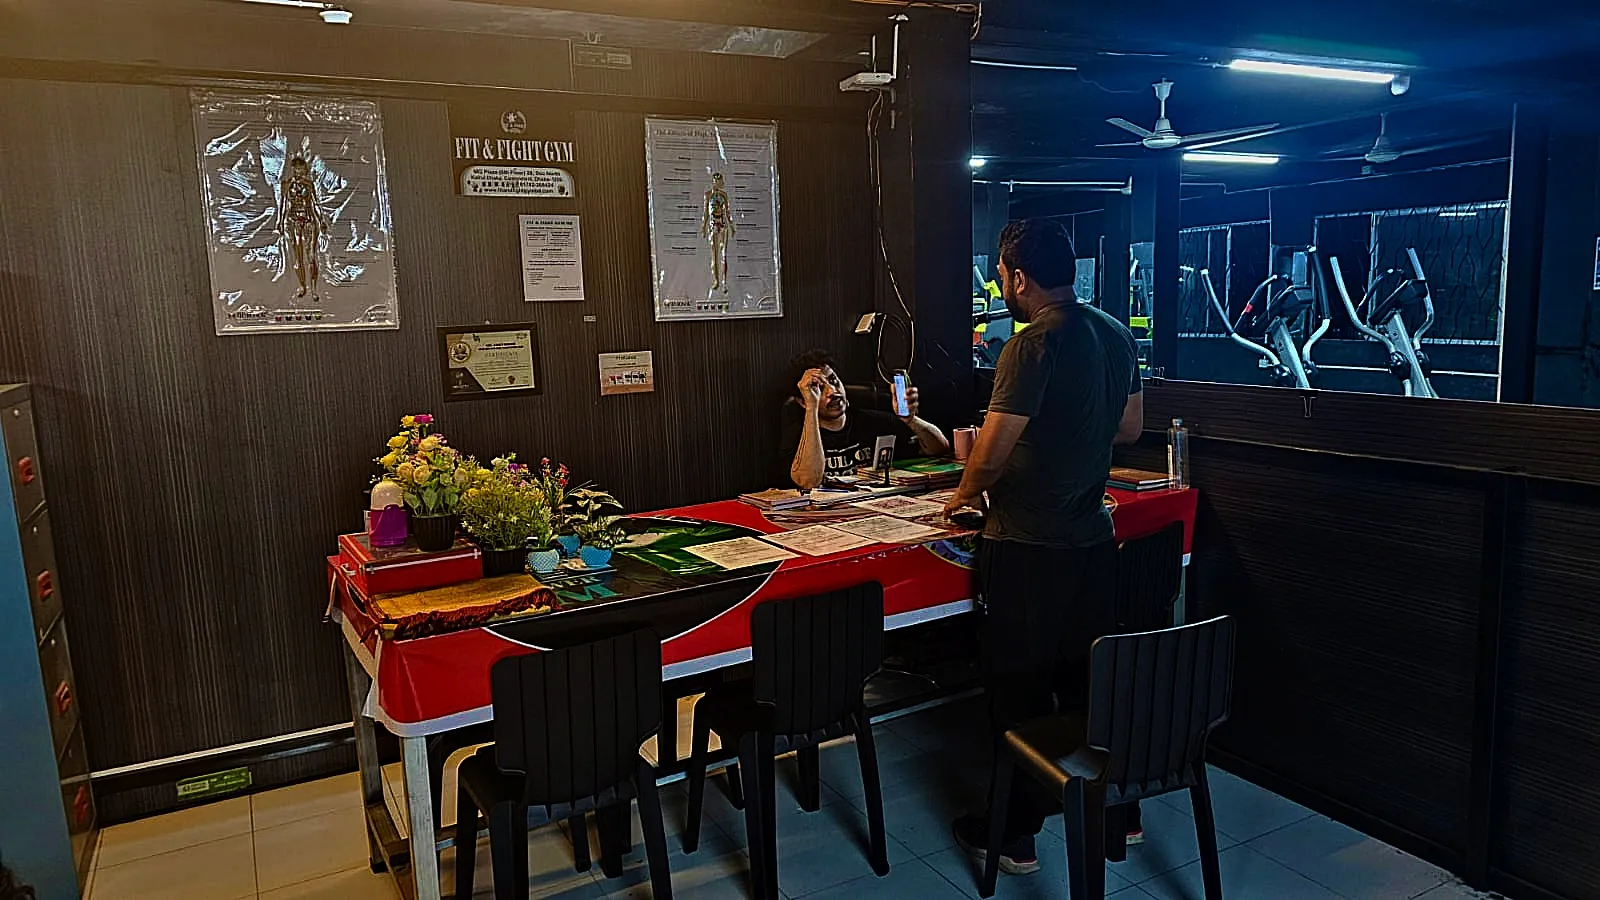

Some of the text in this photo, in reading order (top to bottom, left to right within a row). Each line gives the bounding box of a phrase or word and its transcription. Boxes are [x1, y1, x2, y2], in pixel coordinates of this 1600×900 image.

[455, 137, 575, 162] FIT & FIGHT GYM
